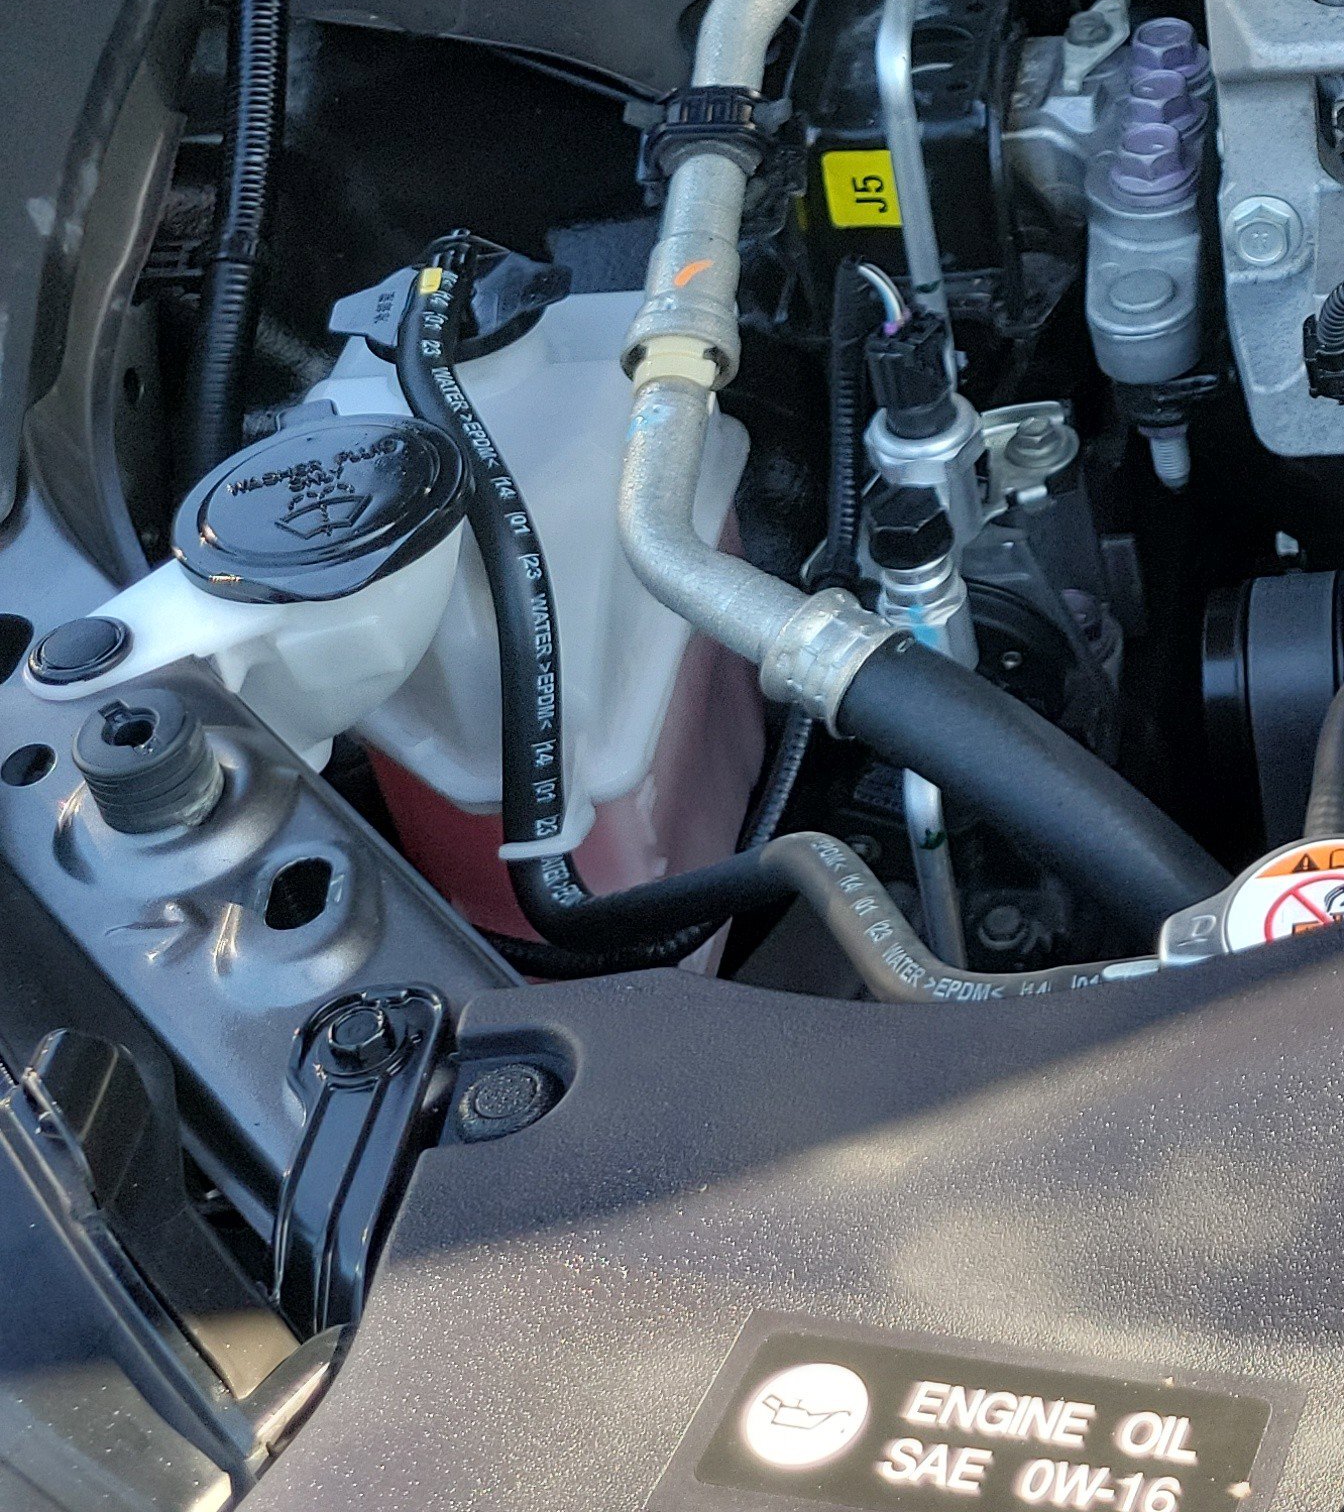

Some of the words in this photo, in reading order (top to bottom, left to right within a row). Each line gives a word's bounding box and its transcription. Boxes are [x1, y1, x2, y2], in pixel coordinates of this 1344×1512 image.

[852, 174, 888, 213] J5
[431, 366, 470, 412] WATER
[531, 593, 552, 659] WATER
[882, 942, 926, 988] WATER
[904, 1380, 1097, 1447] ENGINE
[1120, 1410, 1200, 1464] OIL
[879, 1437, 993, 1491] SAE
